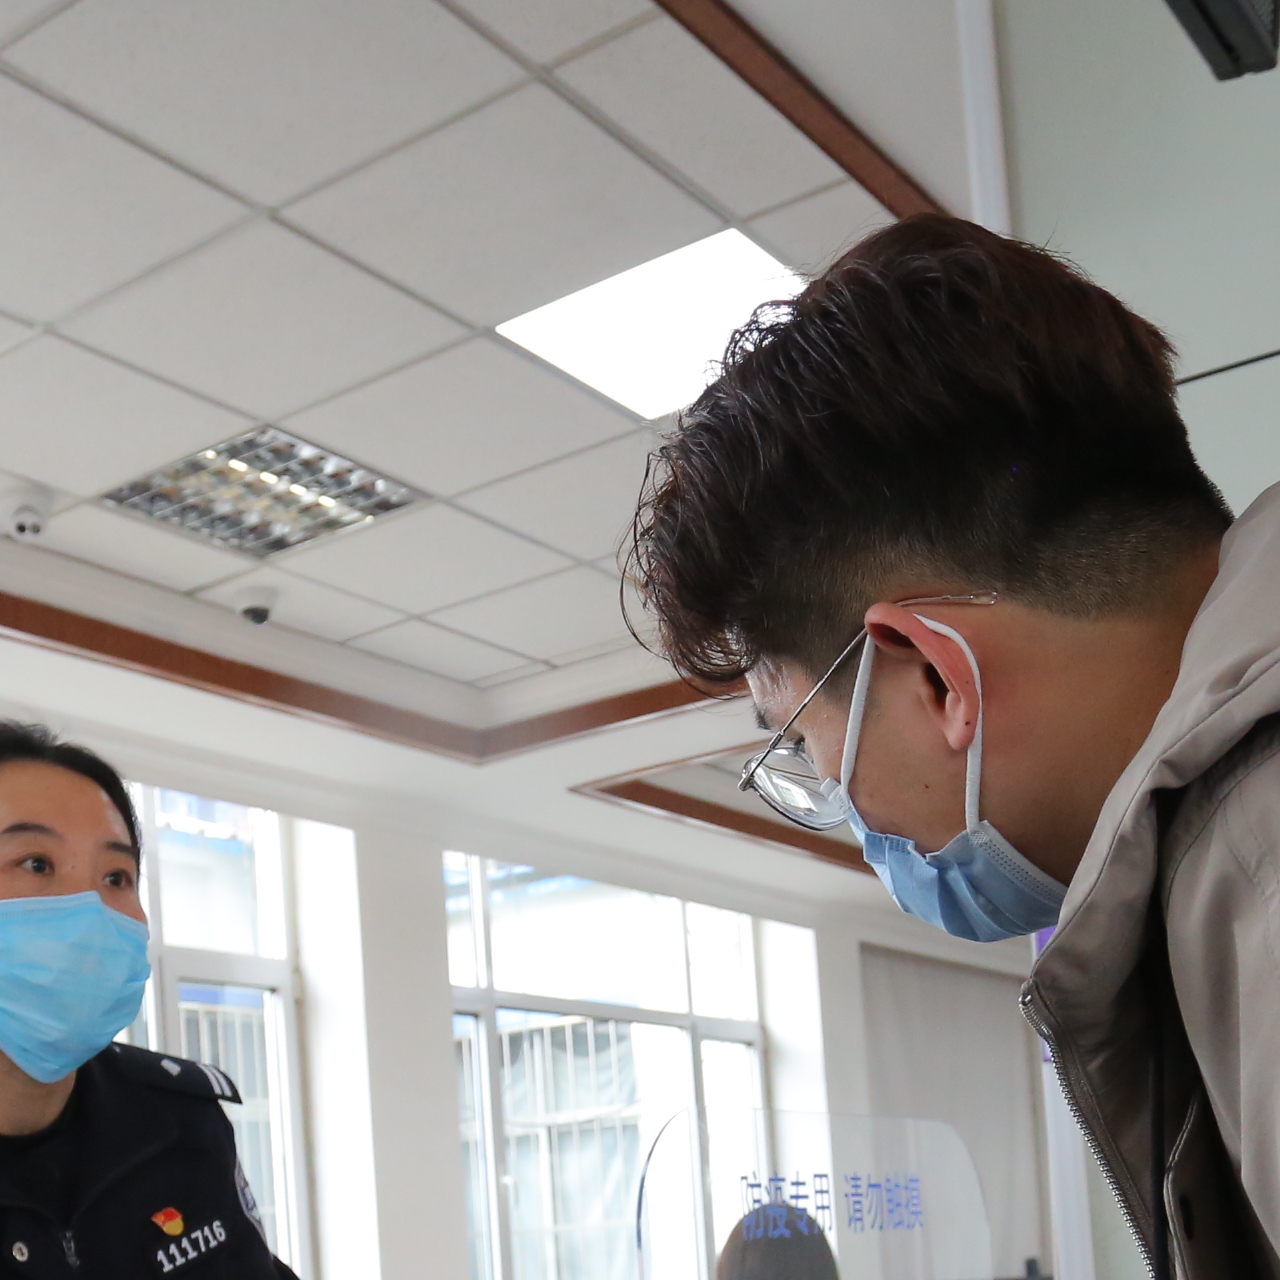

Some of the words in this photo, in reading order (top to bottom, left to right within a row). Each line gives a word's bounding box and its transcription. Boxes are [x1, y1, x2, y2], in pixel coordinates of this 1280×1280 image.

[740, 1171, 832, 1239] 防疫专用
[844, 1171, 923, 1232] 请勿触摸
[156, 1219, 227, 1273] 111716
